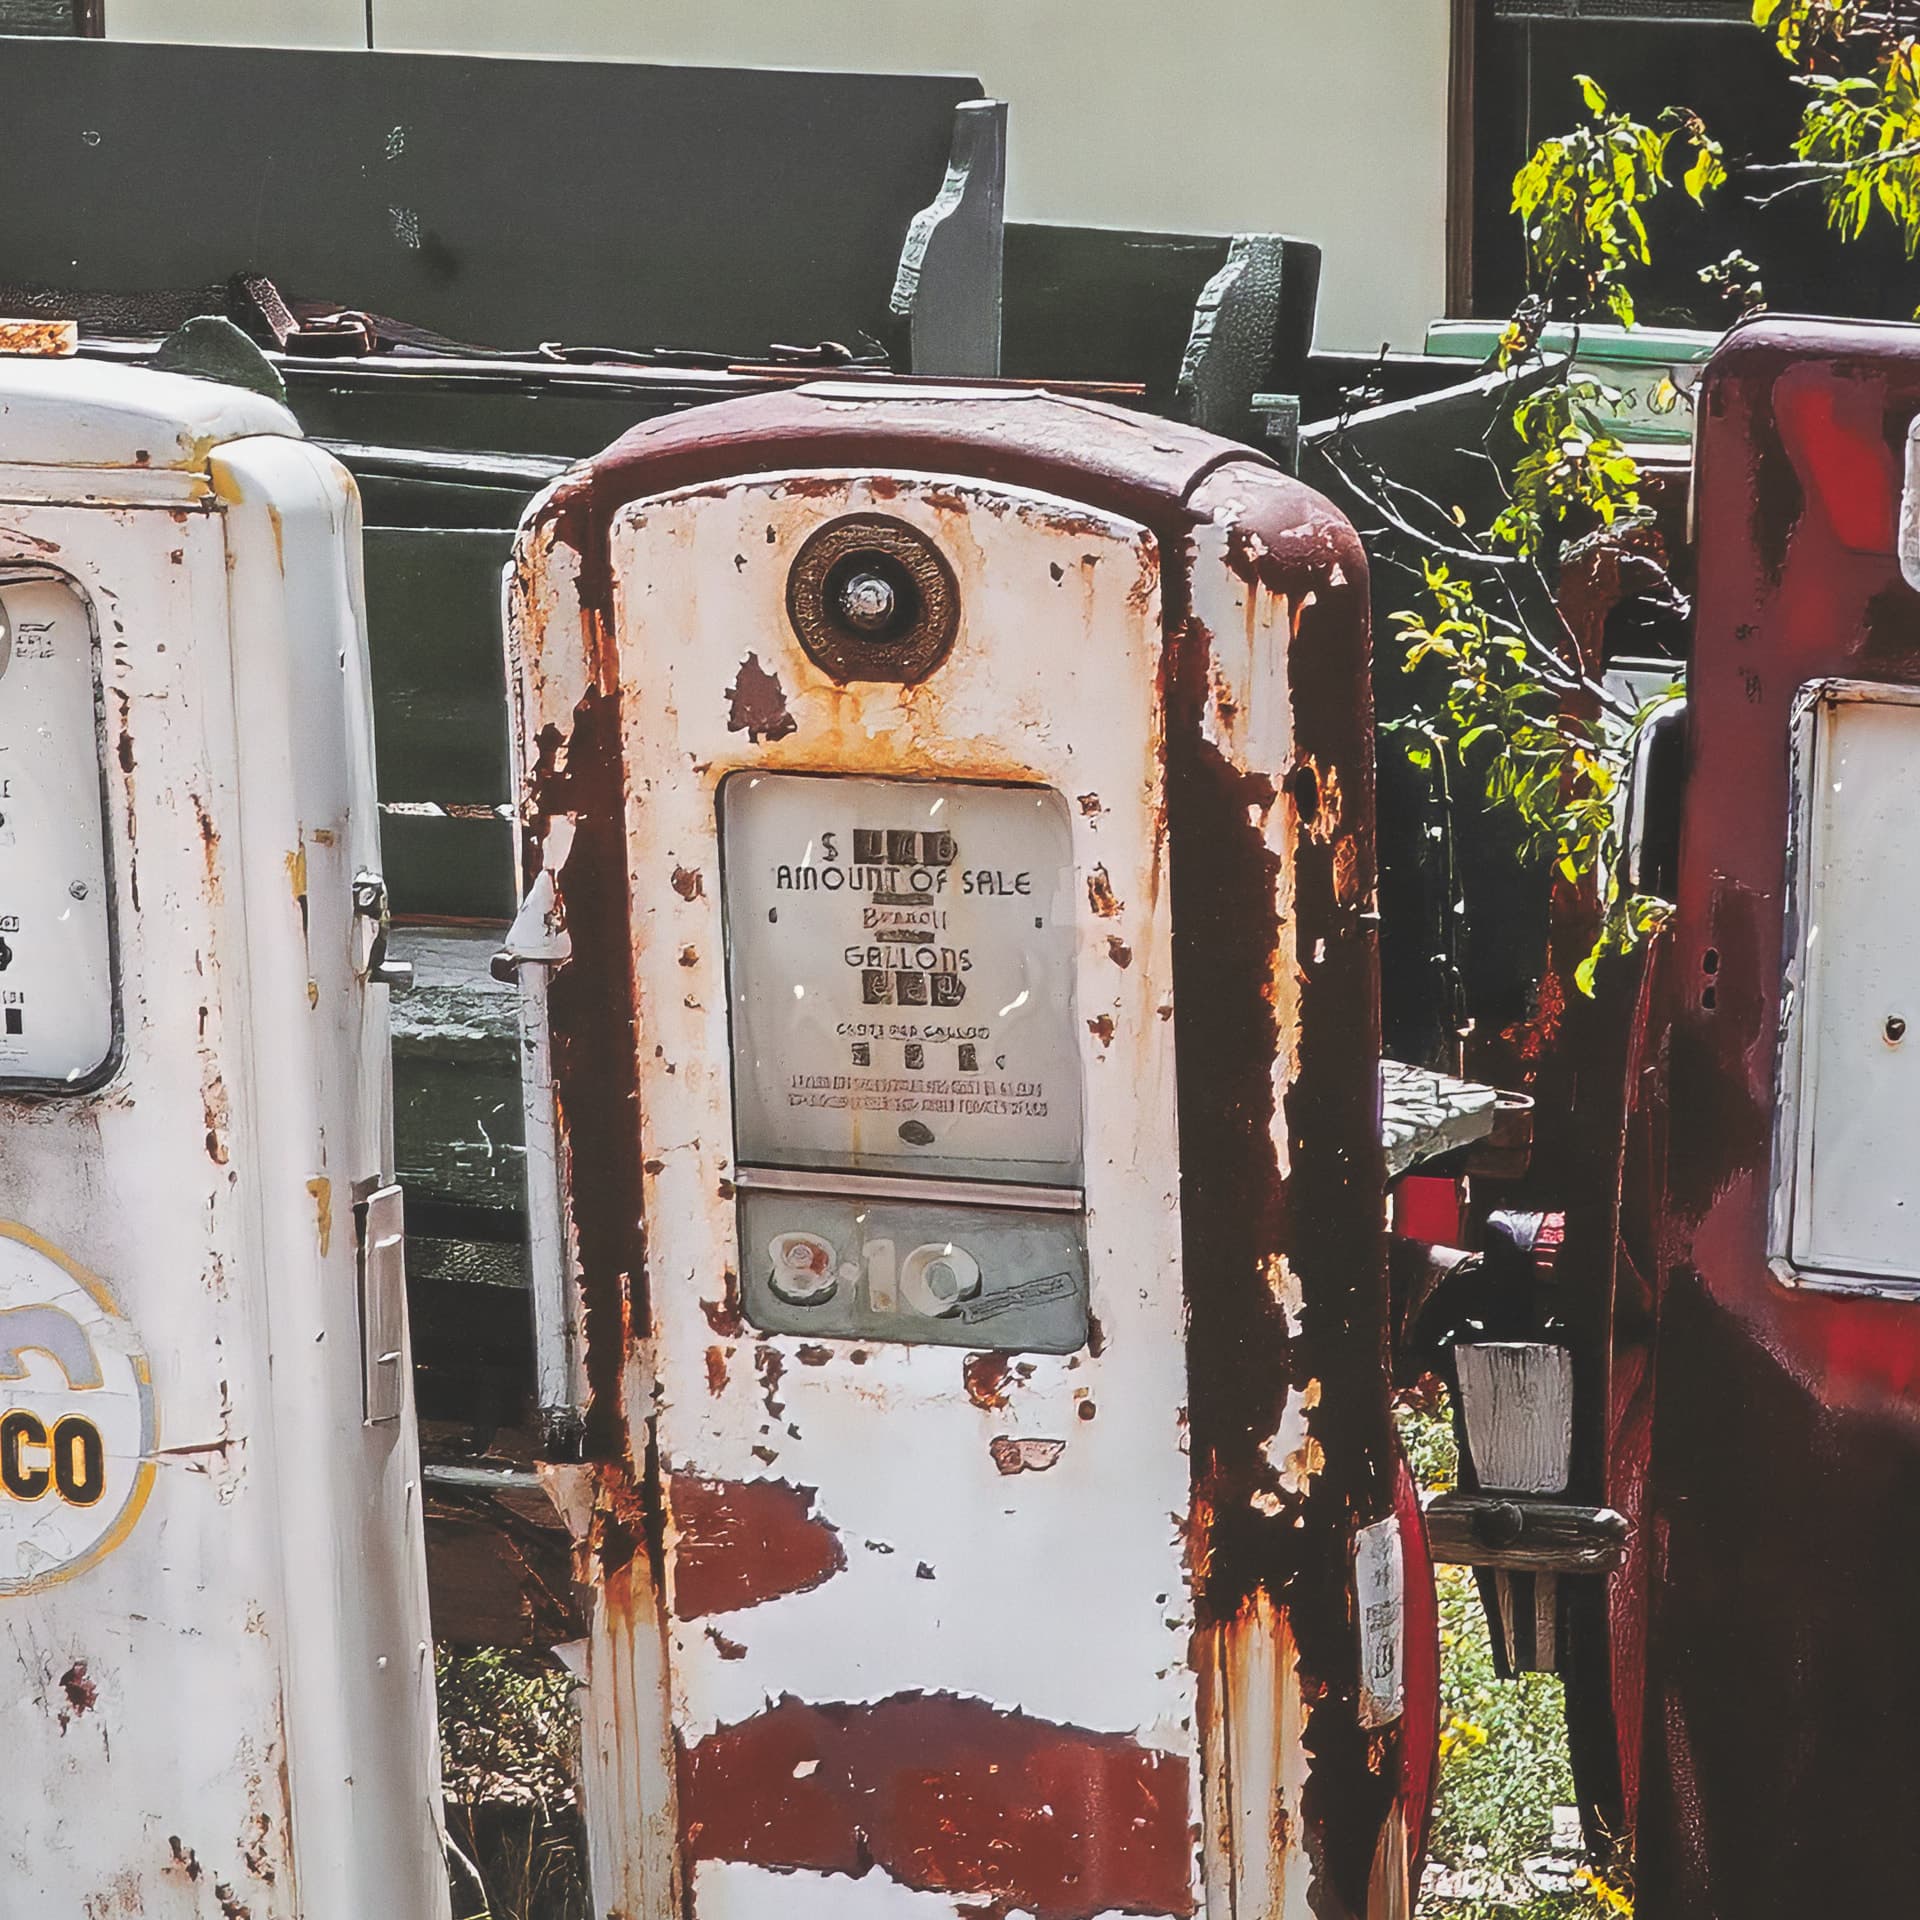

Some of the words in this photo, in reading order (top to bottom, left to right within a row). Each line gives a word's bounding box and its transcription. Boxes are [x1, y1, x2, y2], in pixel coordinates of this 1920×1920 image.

[777, 865, 900, 892] AMOUNT
[910, 868, 949, 893] OF
[961, 870, 1031, 896] SALE
[844, 945, 973, 972] GALLONS
